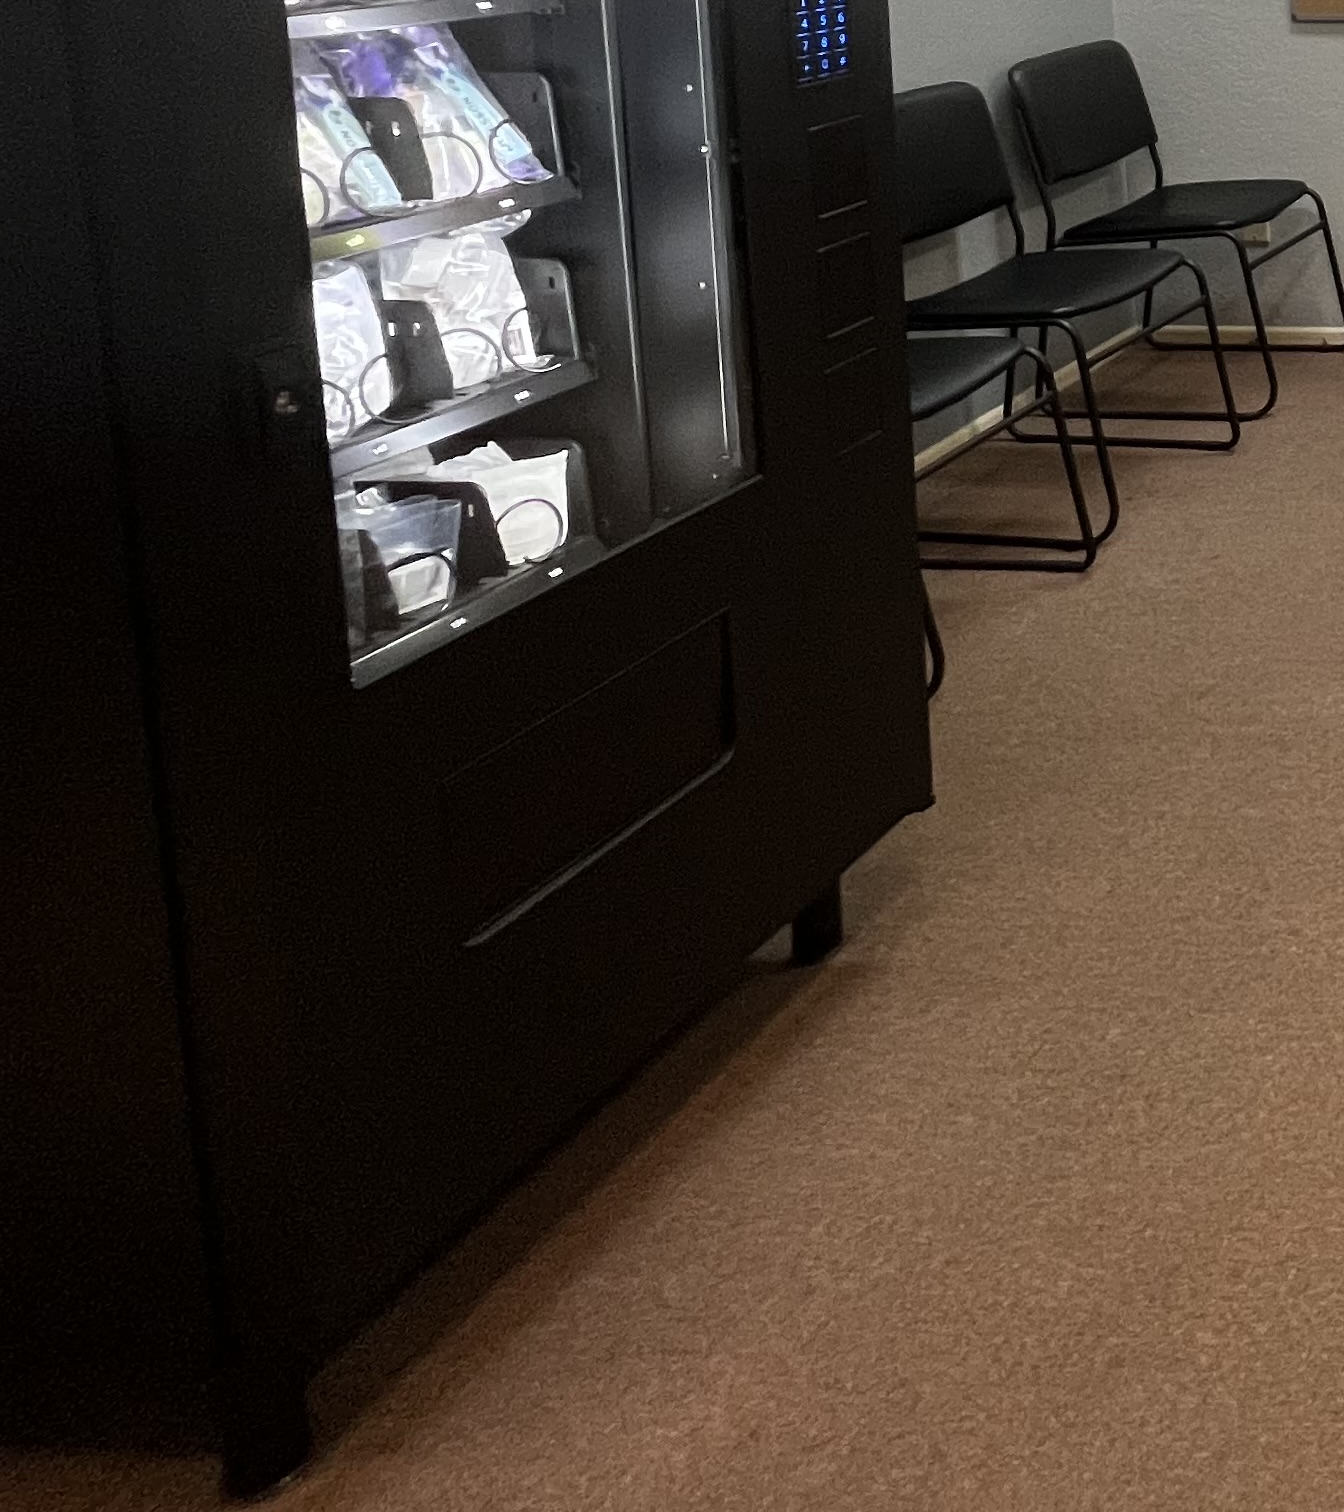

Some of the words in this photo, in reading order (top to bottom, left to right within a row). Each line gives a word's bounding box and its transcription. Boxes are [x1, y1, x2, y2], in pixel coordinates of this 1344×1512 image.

[801, 18, 808, 29] 4
[820, 14, 827, 26] 5
[837, 11, 845, 23] 6
[839, 33, 846, 45] 9
